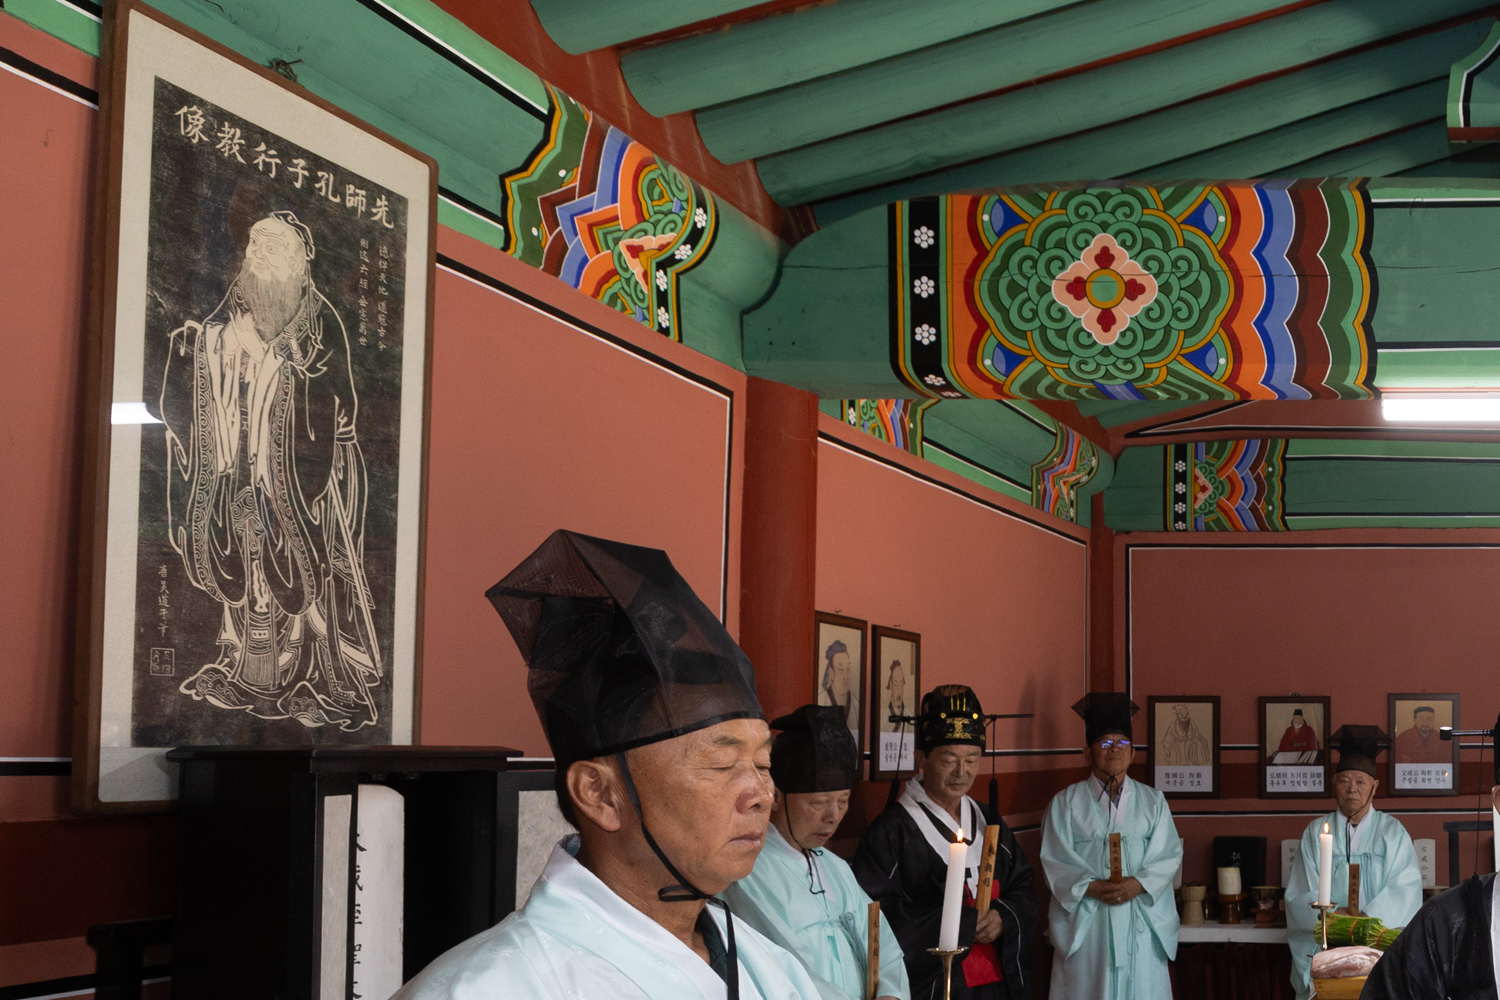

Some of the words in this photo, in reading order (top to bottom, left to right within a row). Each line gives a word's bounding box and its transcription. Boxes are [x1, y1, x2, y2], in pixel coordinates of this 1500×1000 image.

[174, 105, 394, 229] 先師孔子行教像
